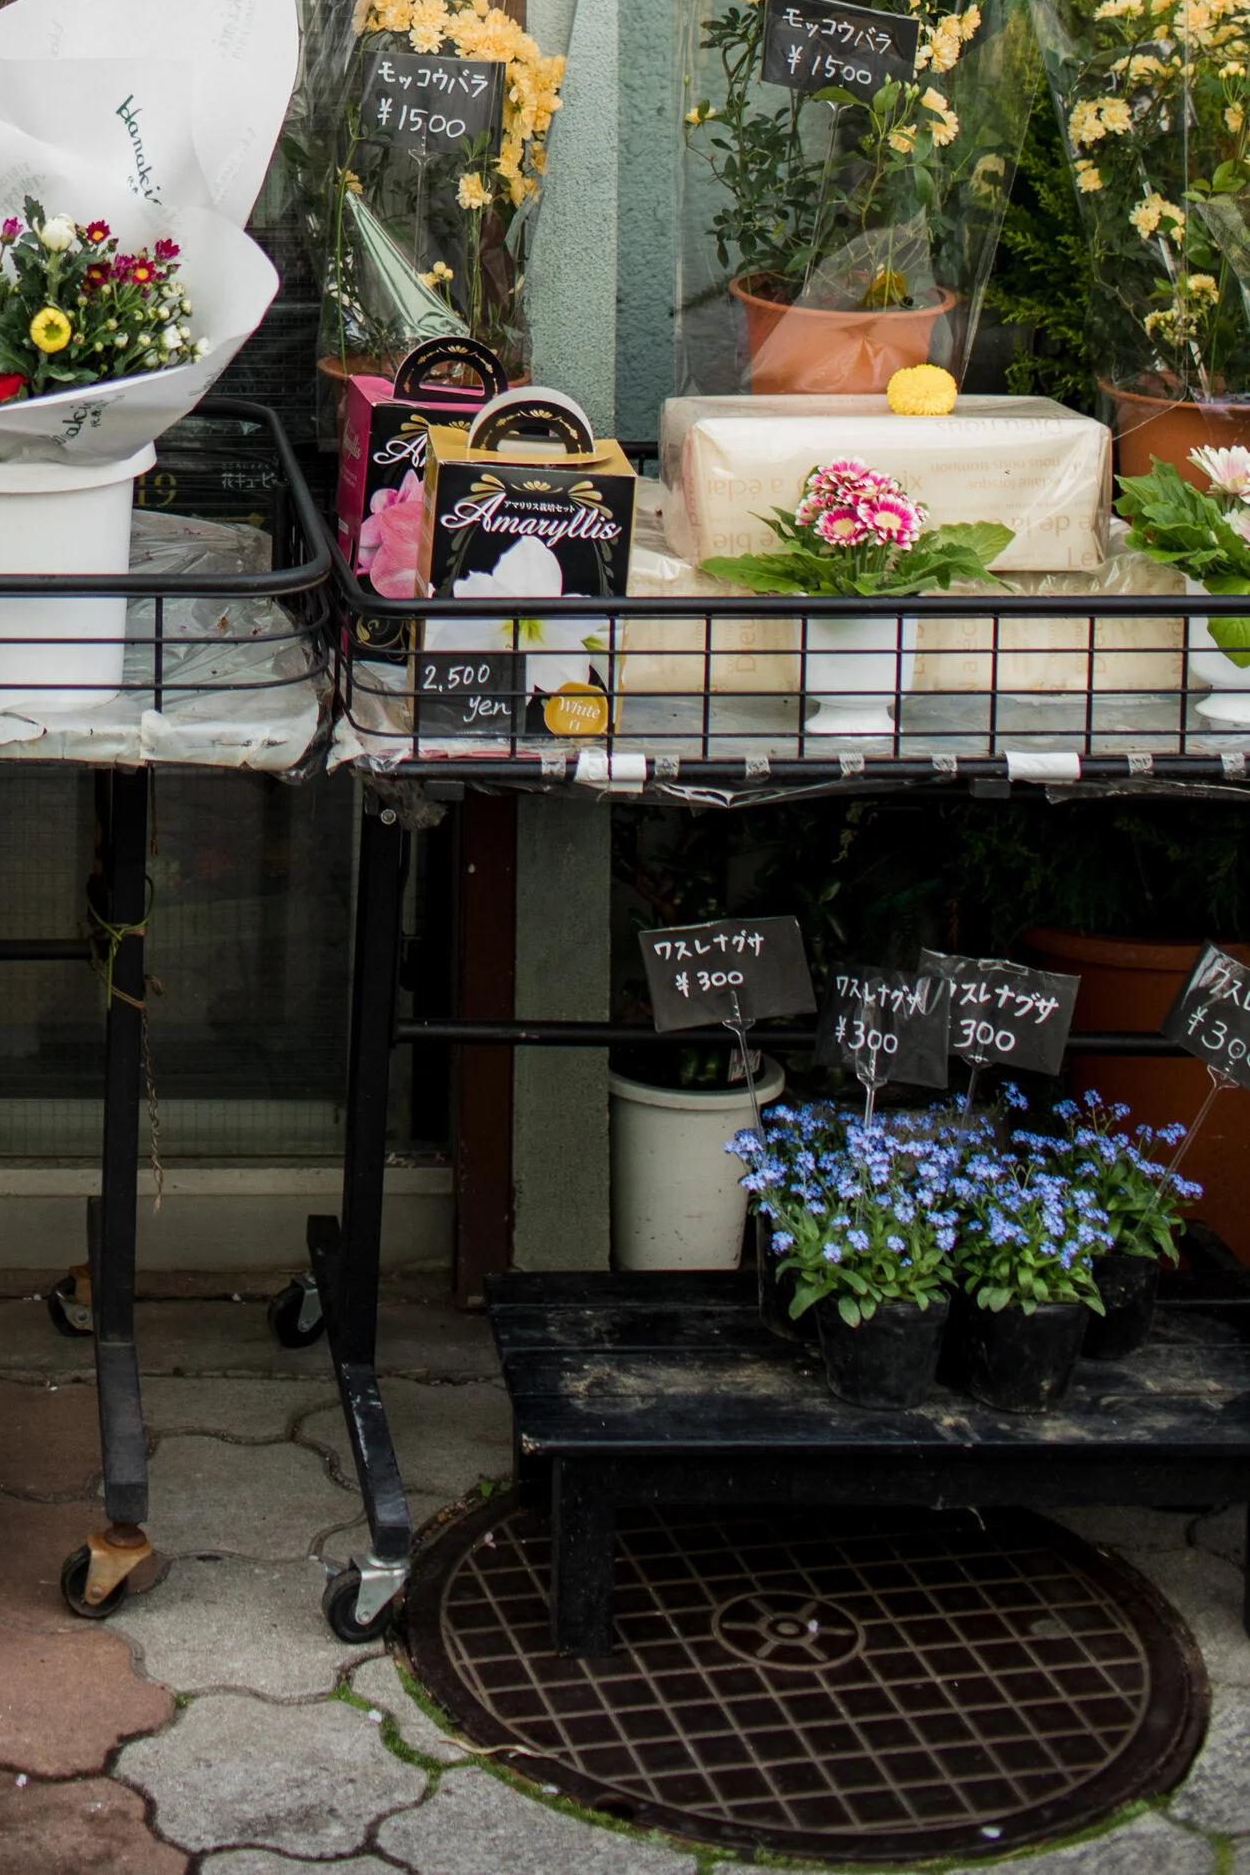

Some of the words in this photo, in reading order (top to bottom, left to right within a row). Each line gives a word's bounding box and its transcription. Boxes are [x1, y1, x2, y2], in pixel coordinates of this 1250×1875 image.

[782, 7, 892, 55] モッコウバラ
[377, 61, 488, 99] モッコウバラ
[440, 492, 622, 548] Amaryllis
[504, 499, 576, 514] アマリリス栽培セット
[463, 696, 511, 722] yen
[558, 696, 601, 719] White
[653, 929, 765, 961] ワスレナグサ
[836, 976, 922, 1015] ワスレナグサ
